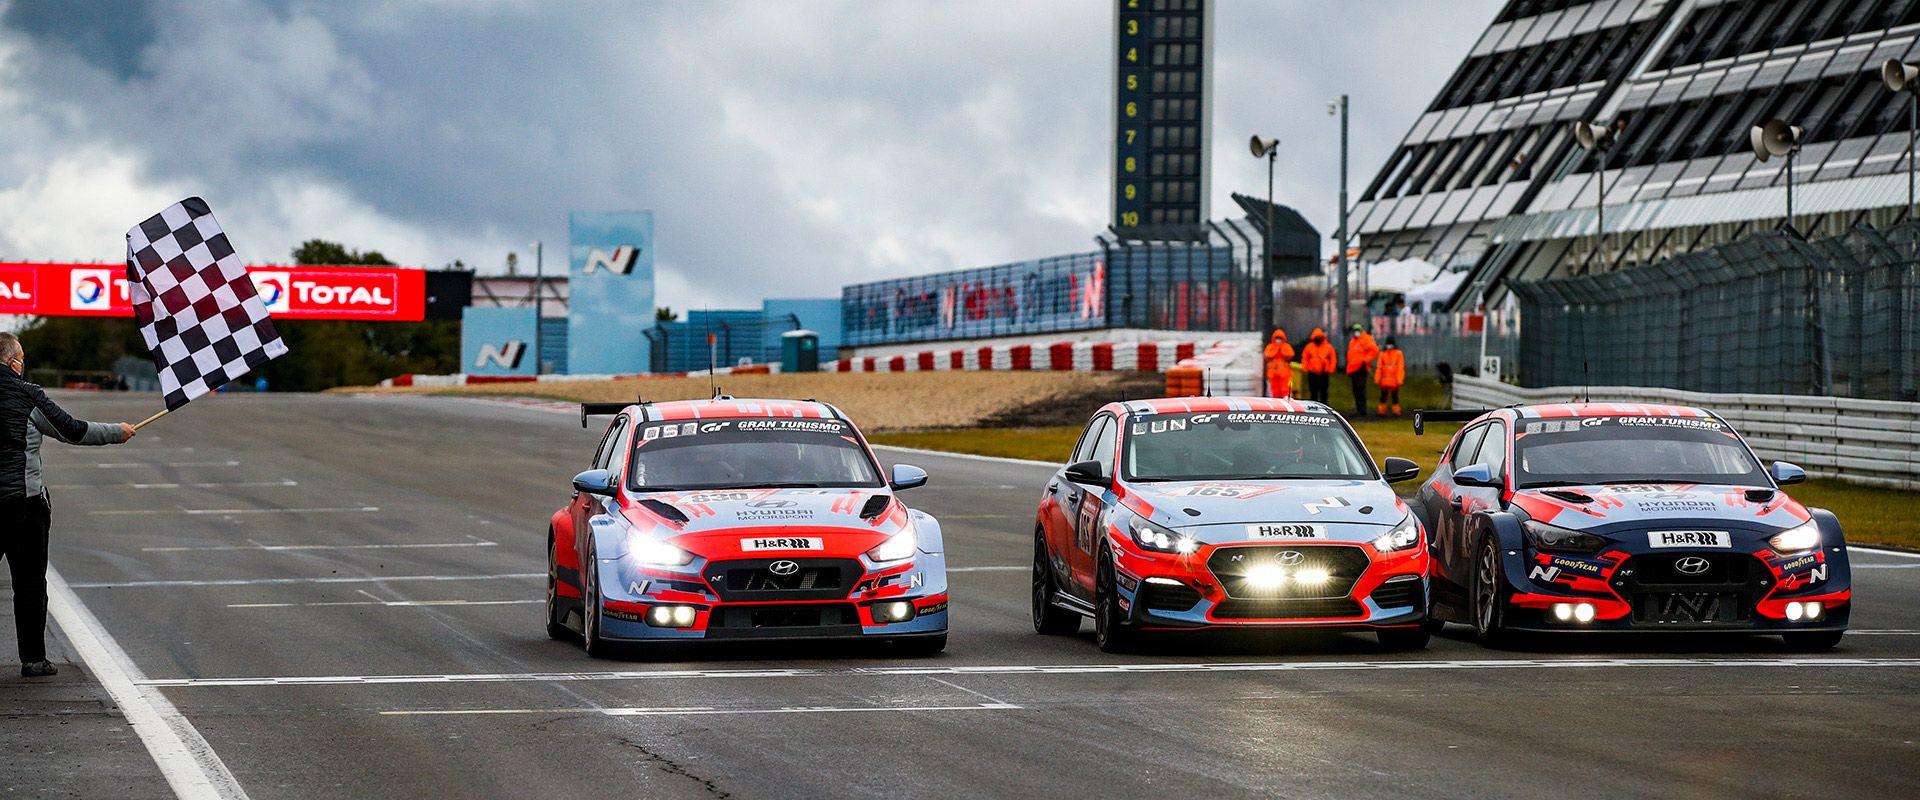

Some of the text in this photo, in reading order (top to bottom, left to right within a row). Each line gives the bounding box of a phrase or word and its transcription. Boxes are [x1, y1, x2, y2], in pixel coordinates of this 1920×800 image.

[1127, 19, 1138, 36] 3
[1126, 47, 1138, 62] 4
[1126, 74, 1138, 90] 5
[1126, 102, 1138, 118] 6
[1126, 130, 1136, 144] 7
[1125, 156, 1136, 172] 8
[1125, 184, 1136, 200] 9
[1122, 211, 1138, 228] 10
[292, 281, 392, 305] TOTAL
[1484, 358, 1498, 374] 49
[738, 420, 841, 430] GRAN TURISMO
[1270, 414, 1330, 424] TURISMO
[1660, 418, 1721, 429] TURISMO
[1132, 419, 1187, 436] LUN
[1186, 486, 1240, 497] 165
[1259, 526, 1294, 537] H&R
[1662, 532, 1697, 544] H&R
[754, 539, 789, 548] H&R
[1554, 558, 1598, 572] GOODYEAR
[1784, 556, 1814, 570] GOODYEAR
